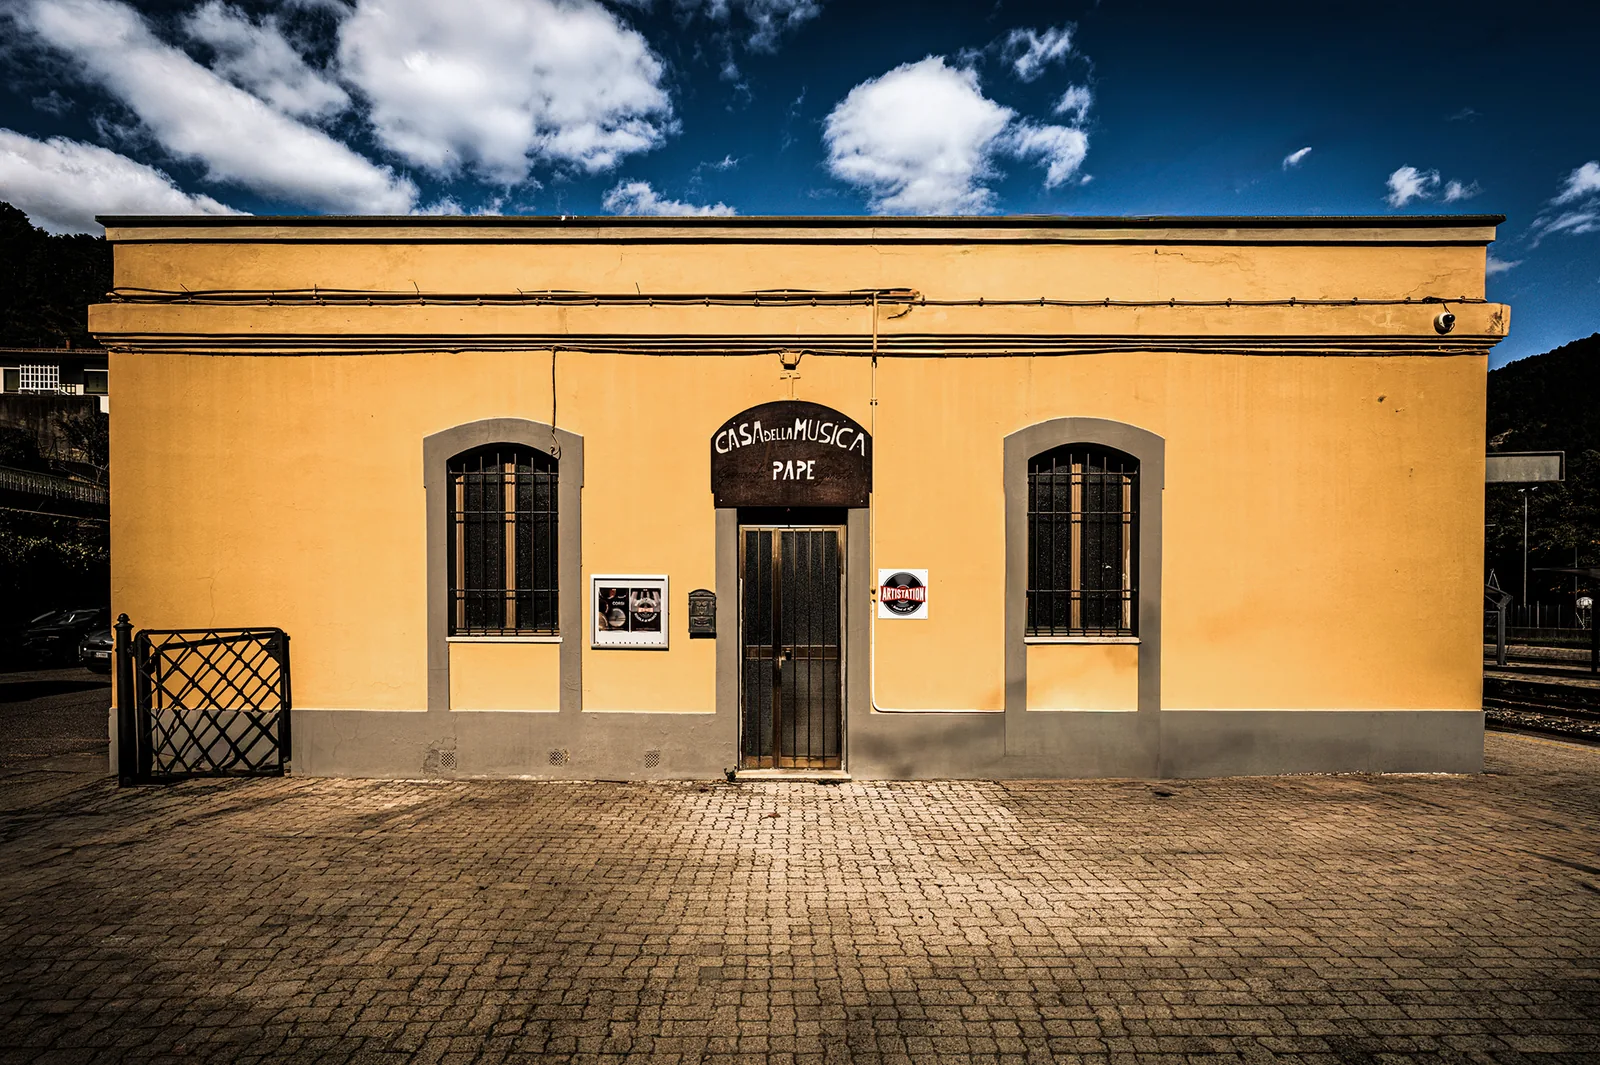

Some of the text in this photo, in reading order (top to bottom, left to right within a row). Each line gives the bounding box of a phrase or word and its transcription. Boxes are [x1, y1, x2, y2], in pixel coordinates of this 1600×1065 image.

[715, 417, 865, 457] CASA DELLA MUSICA
[772, 460, 816, 481] PAPE
[882, 587, 925, 601] ARTISTATION
